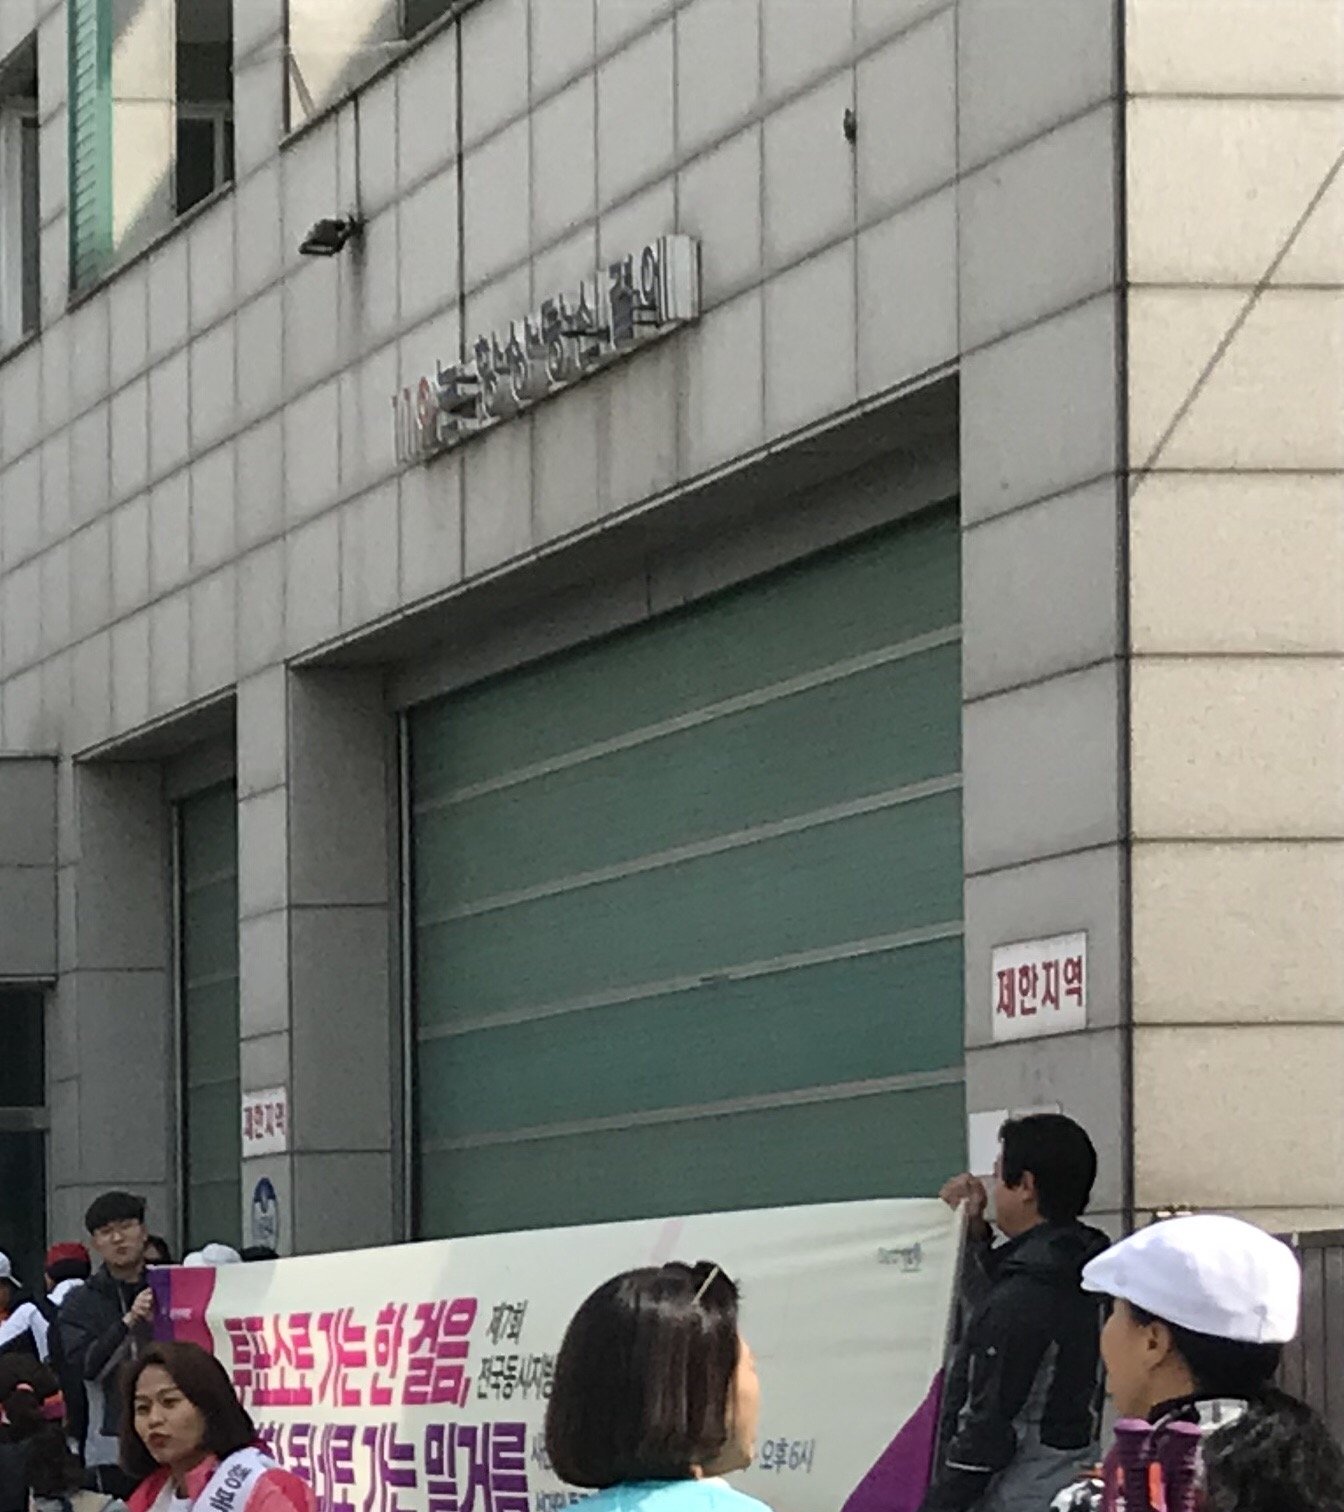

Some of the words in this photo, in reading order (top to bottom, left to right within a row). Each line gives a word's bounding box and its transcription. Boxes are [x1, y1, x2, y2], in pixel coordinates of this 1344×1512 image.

[996, 955, 1083, 1018] 제한지역
[224, 1313, 314, 1406] 투표소로
[317, 1307, 367, 1406] 가는
